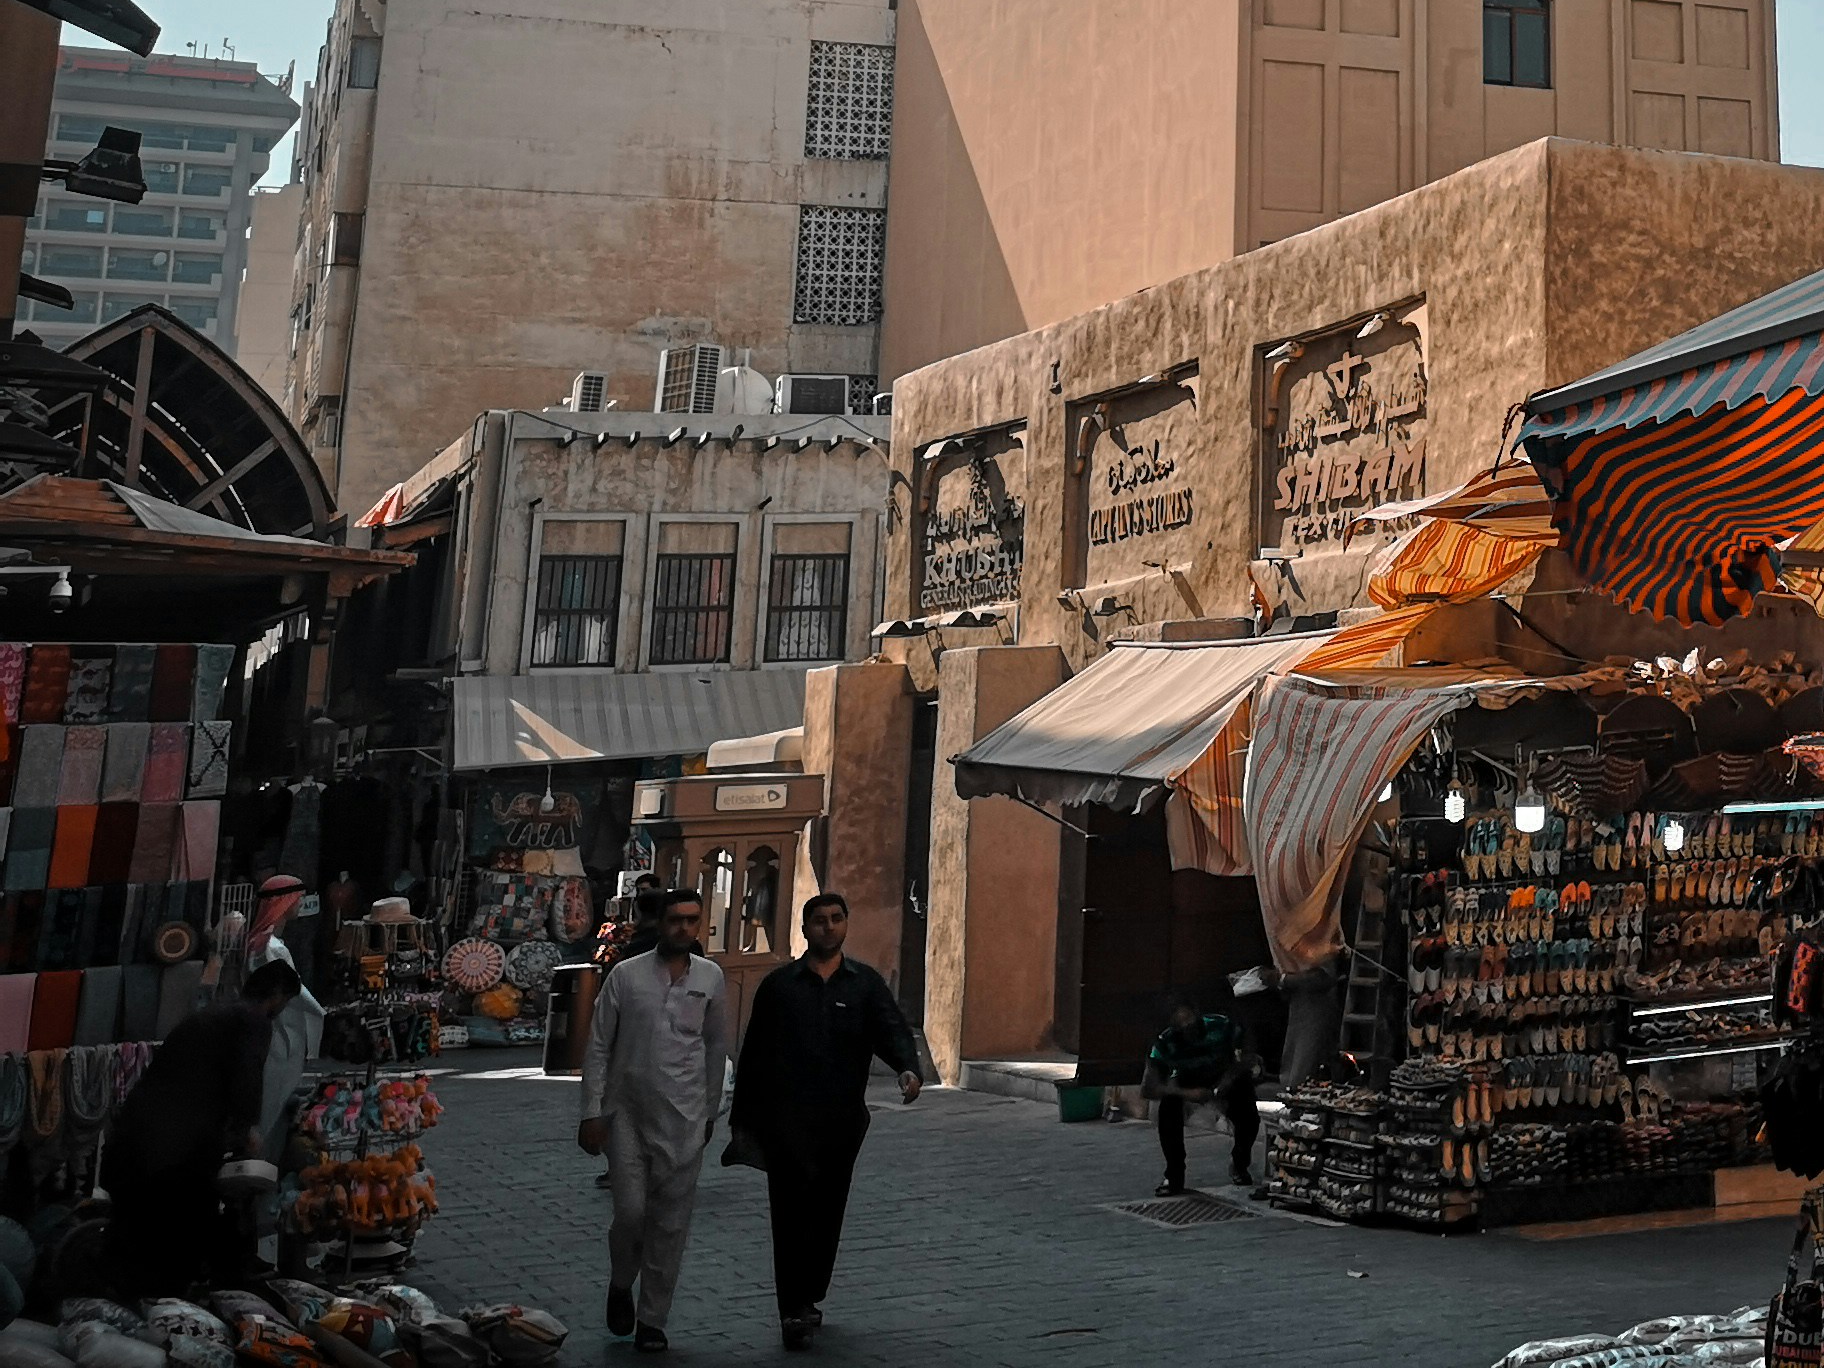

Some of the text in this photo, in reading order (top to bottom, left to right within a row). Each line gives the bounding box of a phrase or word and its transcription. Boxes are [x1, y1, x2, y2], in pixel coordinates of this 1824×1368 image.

[1273, 439, 1427, 513] SHIBAM
[923, 544, 1023, 587] KHUSHI
[723, 793, 766, 806] etisalat
